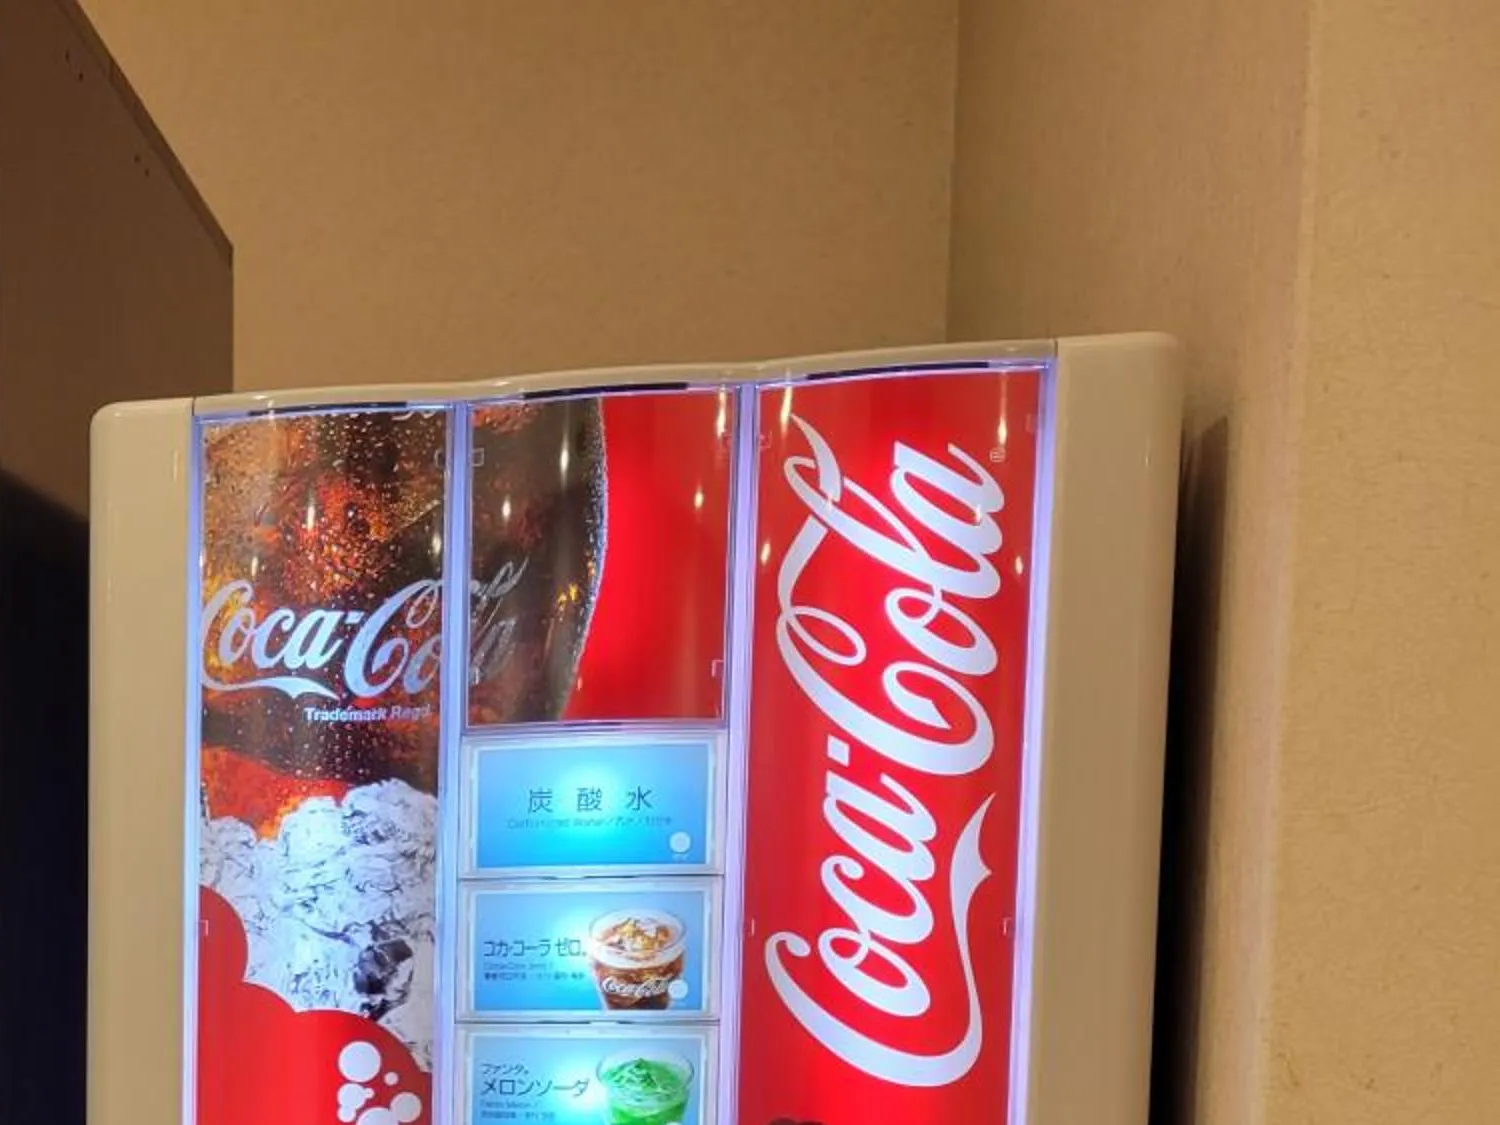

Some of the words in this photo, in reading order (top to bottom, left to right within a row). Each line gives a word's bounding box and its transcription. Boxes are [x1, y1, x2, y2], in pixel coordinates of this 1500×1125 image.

[304, 705, 387, 721] Trademark
[764, 412, 1005, 1088] Coca-Cola
[527, 785, 654, 814] 炭酸水
[480, 1078, 590, 1099] メロンソーダ
